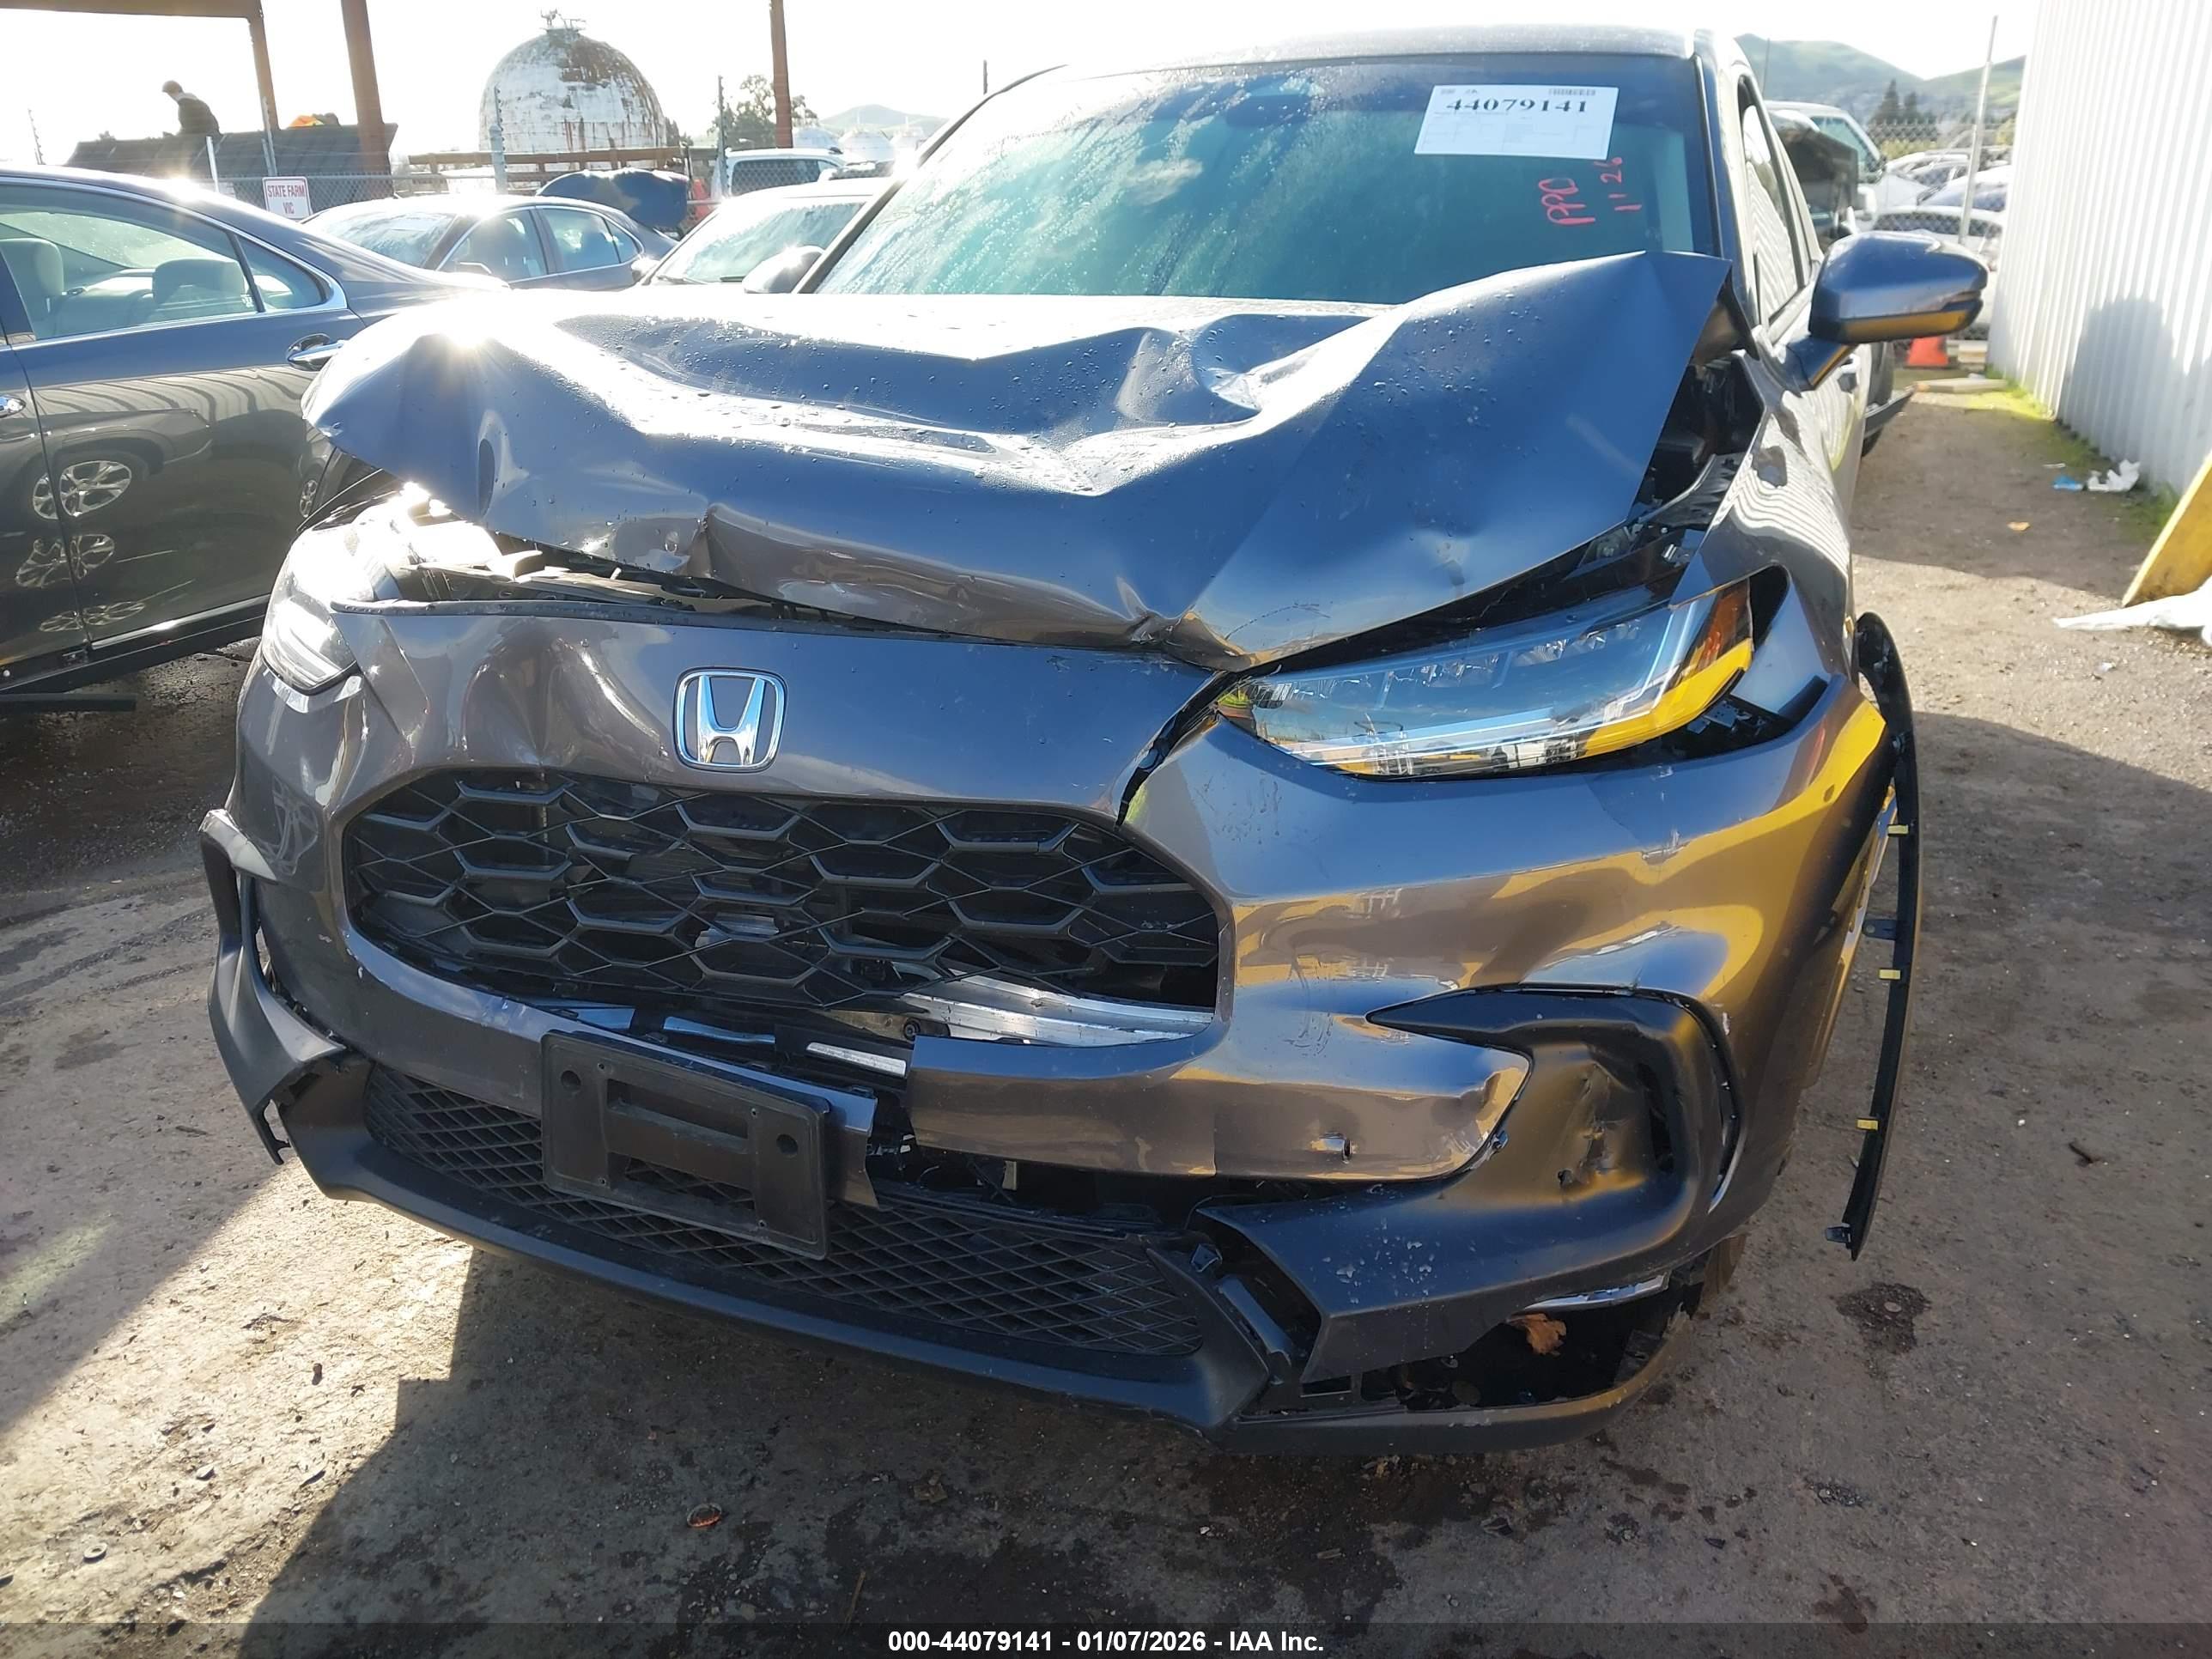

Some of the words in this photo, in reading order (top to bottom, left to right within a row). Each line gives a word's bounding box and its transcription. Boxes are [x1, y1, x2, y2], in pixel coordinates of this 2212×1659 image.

[1446, 98, 1589, 113] 44079141
[268, 185, 286, 198] STATE
[288, 185, 306, 198] FARM
